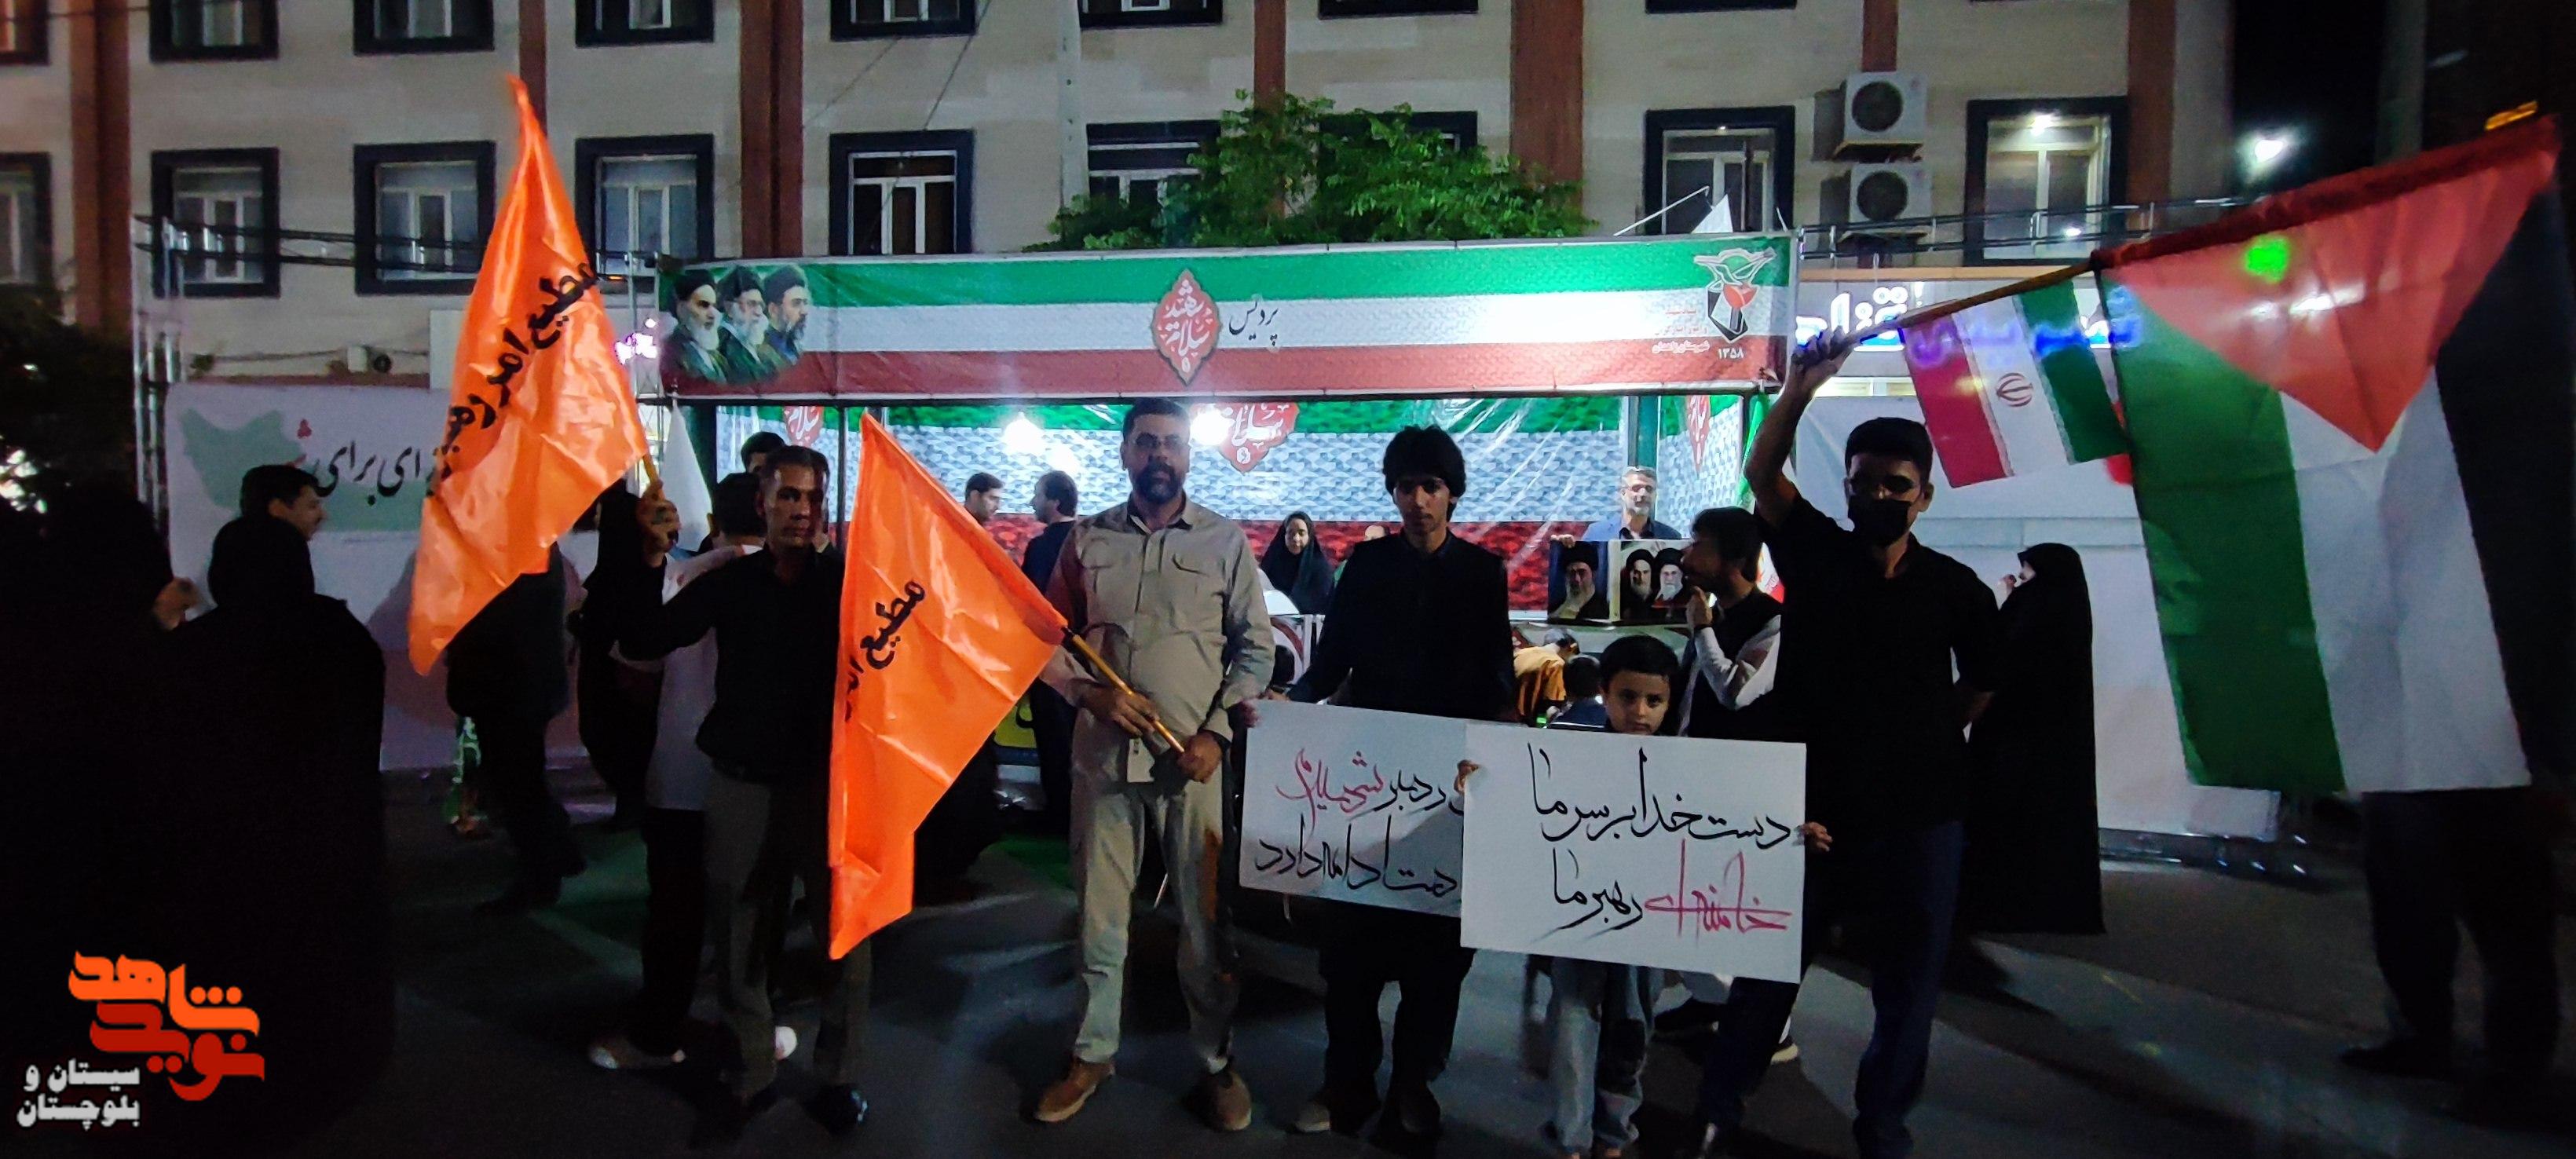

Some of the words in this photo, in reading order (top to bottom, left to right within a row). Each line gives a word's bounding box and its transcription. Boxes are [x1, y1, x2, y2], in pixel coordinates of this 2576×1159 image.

[528, 262, 599, 349] مطیع
[1228, 299, 1279, 346] پردیس
[486, 327, 529, 408] امر
[1718, 346, 1744, 359] ۱۳۵۸
[316, 439, 377, 507] برای
[859, 580, 926, 671] مطیع
[1352, 769, 1447, 818] رهبر
[1527, 741, 1568, 815] ما
[1631, 746, 1703, 838] خدا
[1254, 813, 1323, 879] دارد
[1322, 813, 1392, 890] ادامه
[1540, 801, 1609, 842] سر
[1586, 803, 1636, 841] بر
[1686, 814, 1791, 850] دست
[1552, 847, 1587, 905] ما
[1534, 879, 1644, 941] رهبر
